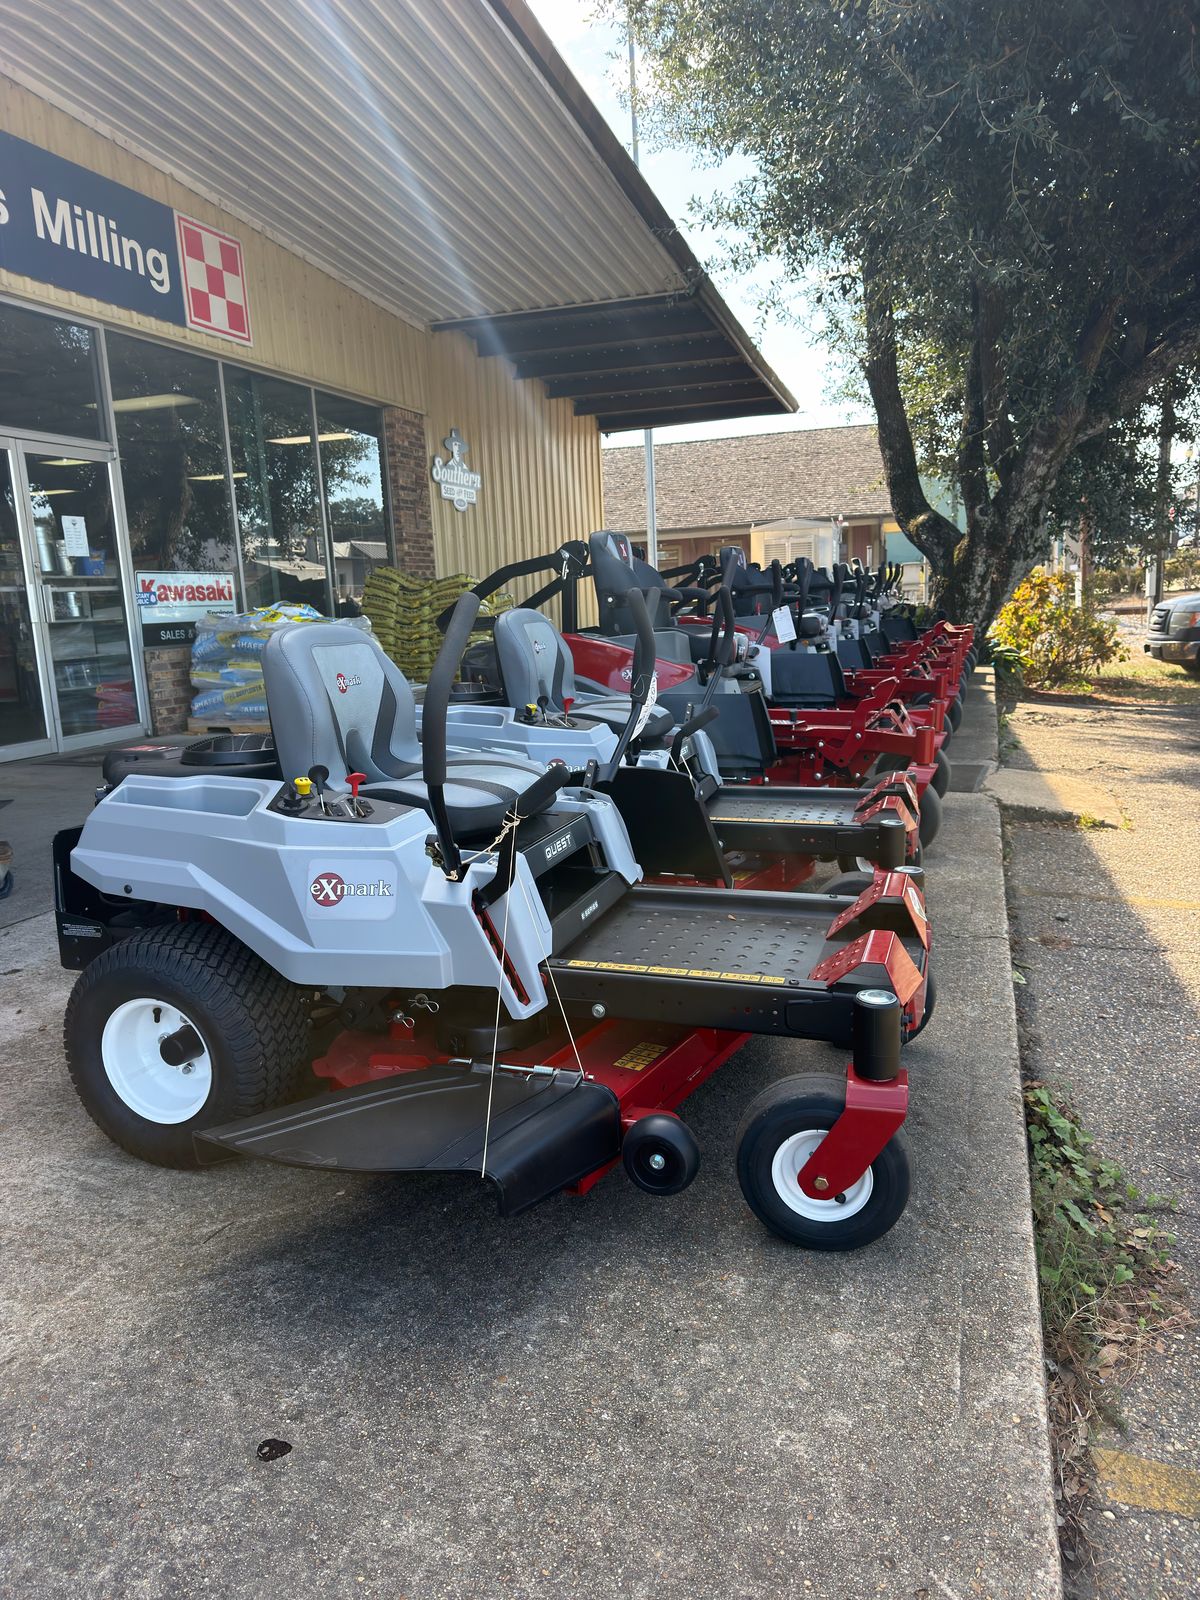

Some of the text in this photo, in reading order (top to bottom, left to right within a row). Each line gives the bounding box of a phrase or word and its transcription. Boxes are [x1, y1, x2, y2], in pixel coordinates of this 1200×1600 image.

[31, 187, 170, 294] Milling
[432, 456, 481, 488] Southern
[141, 579, 233, 602] Kawasaki
[161, 629, 193, 640] SALES &
[545, 834, 571, 859] QUEST
[310, 878, 391, 901] eXmark
